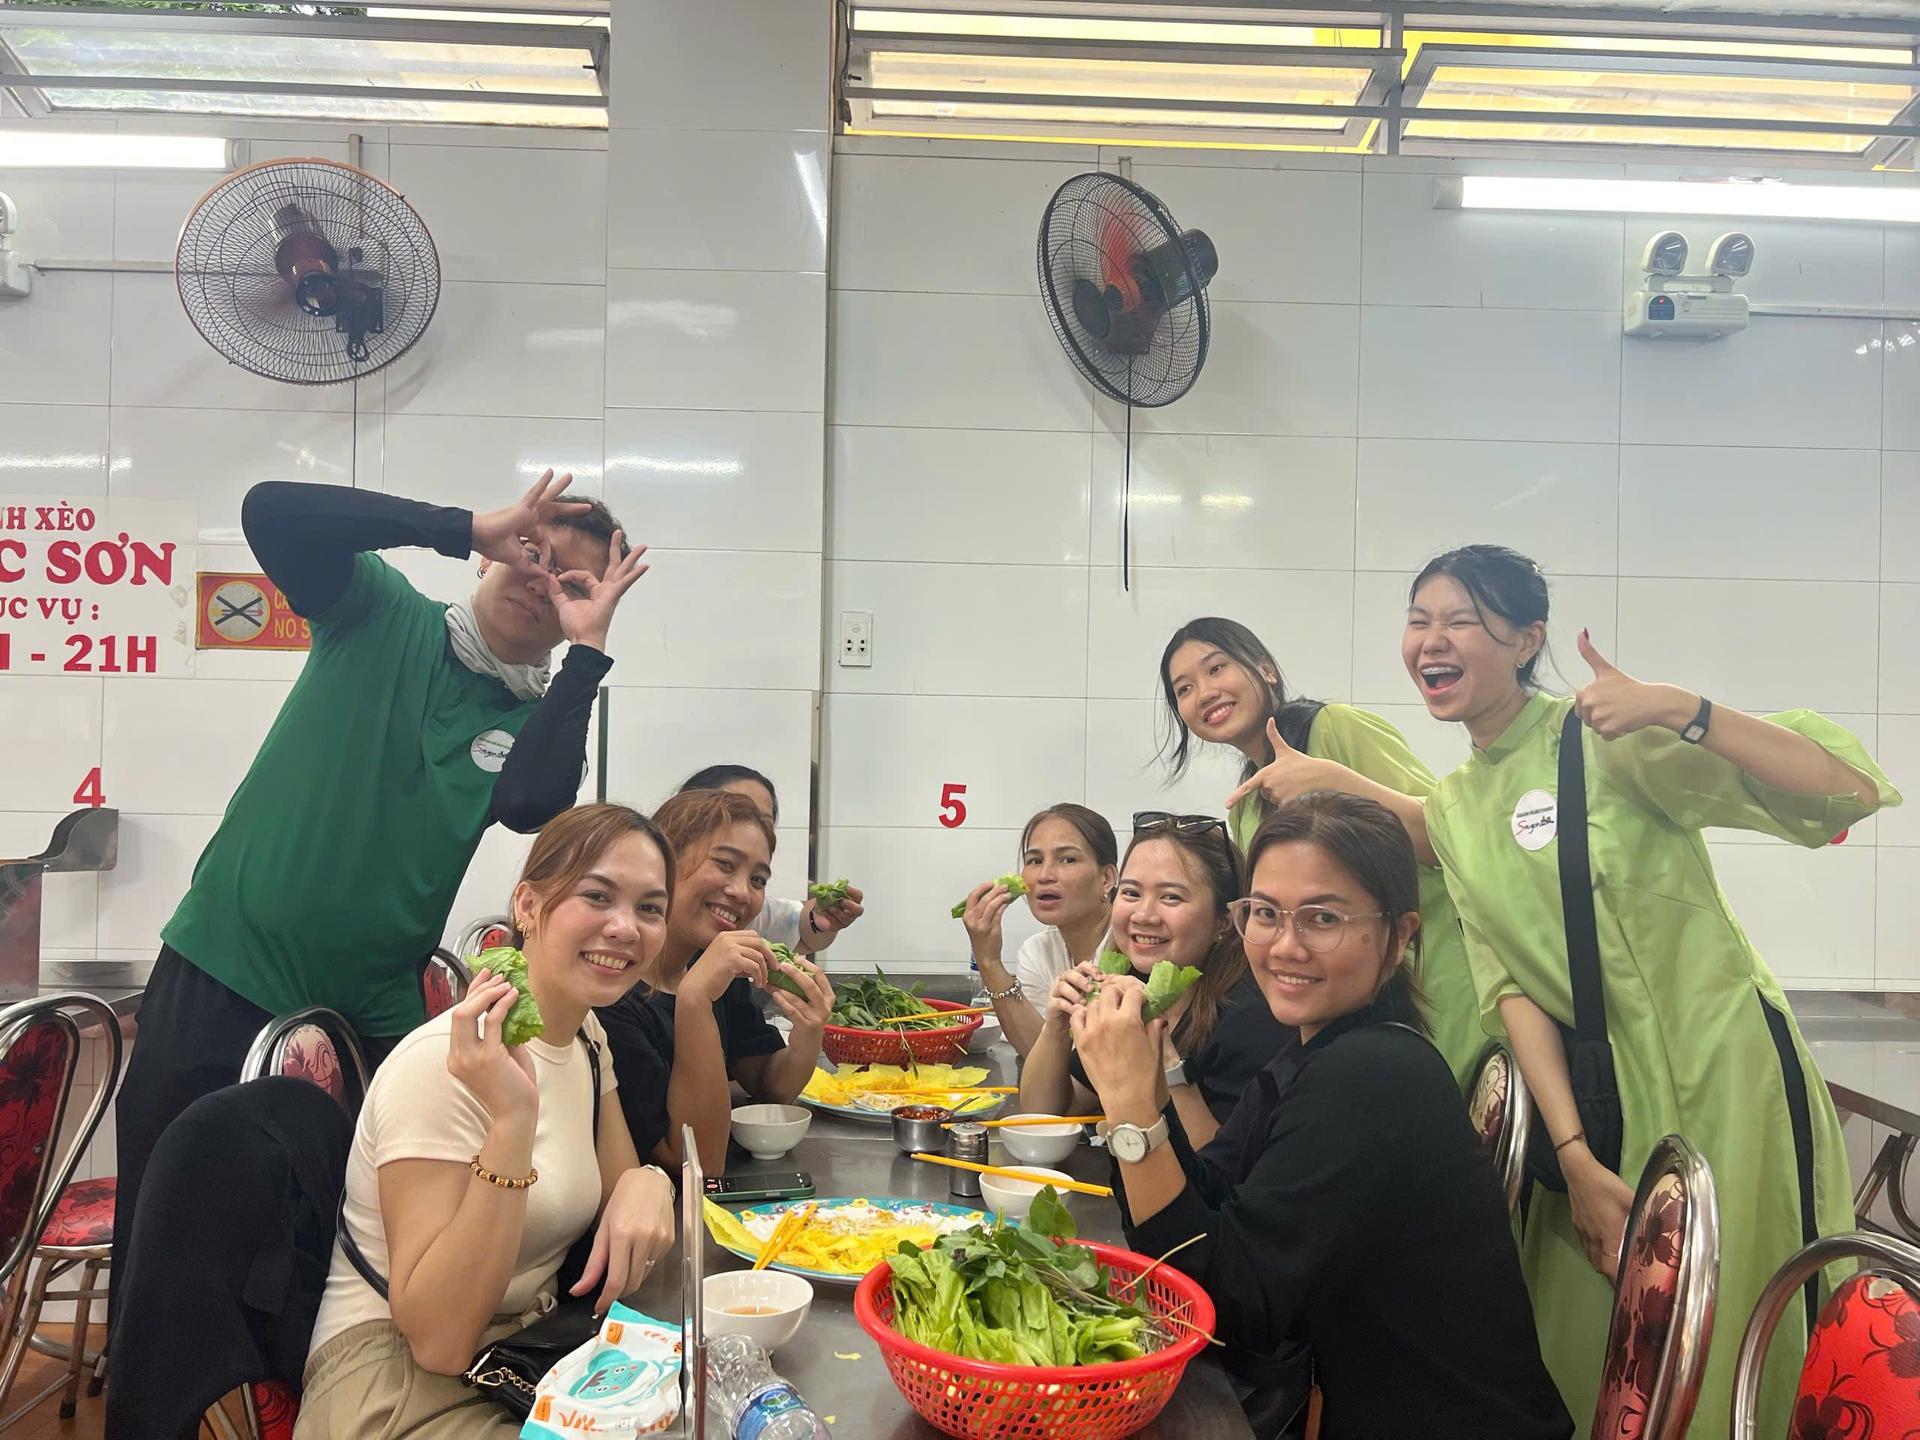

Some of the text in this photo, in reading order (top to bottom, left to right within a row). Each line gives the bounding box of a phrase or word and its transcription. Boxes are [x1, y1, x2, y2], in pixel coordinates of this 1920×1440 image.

[0, 500, 96, 531] H XÈO
[46, 532, 177, 586] SƠN
[274, 617, 297, 639] NO
[63, 634, 157, 673] 21H
[73, 767, 106, 809] 4
[939, 783, 967, 829] 5
